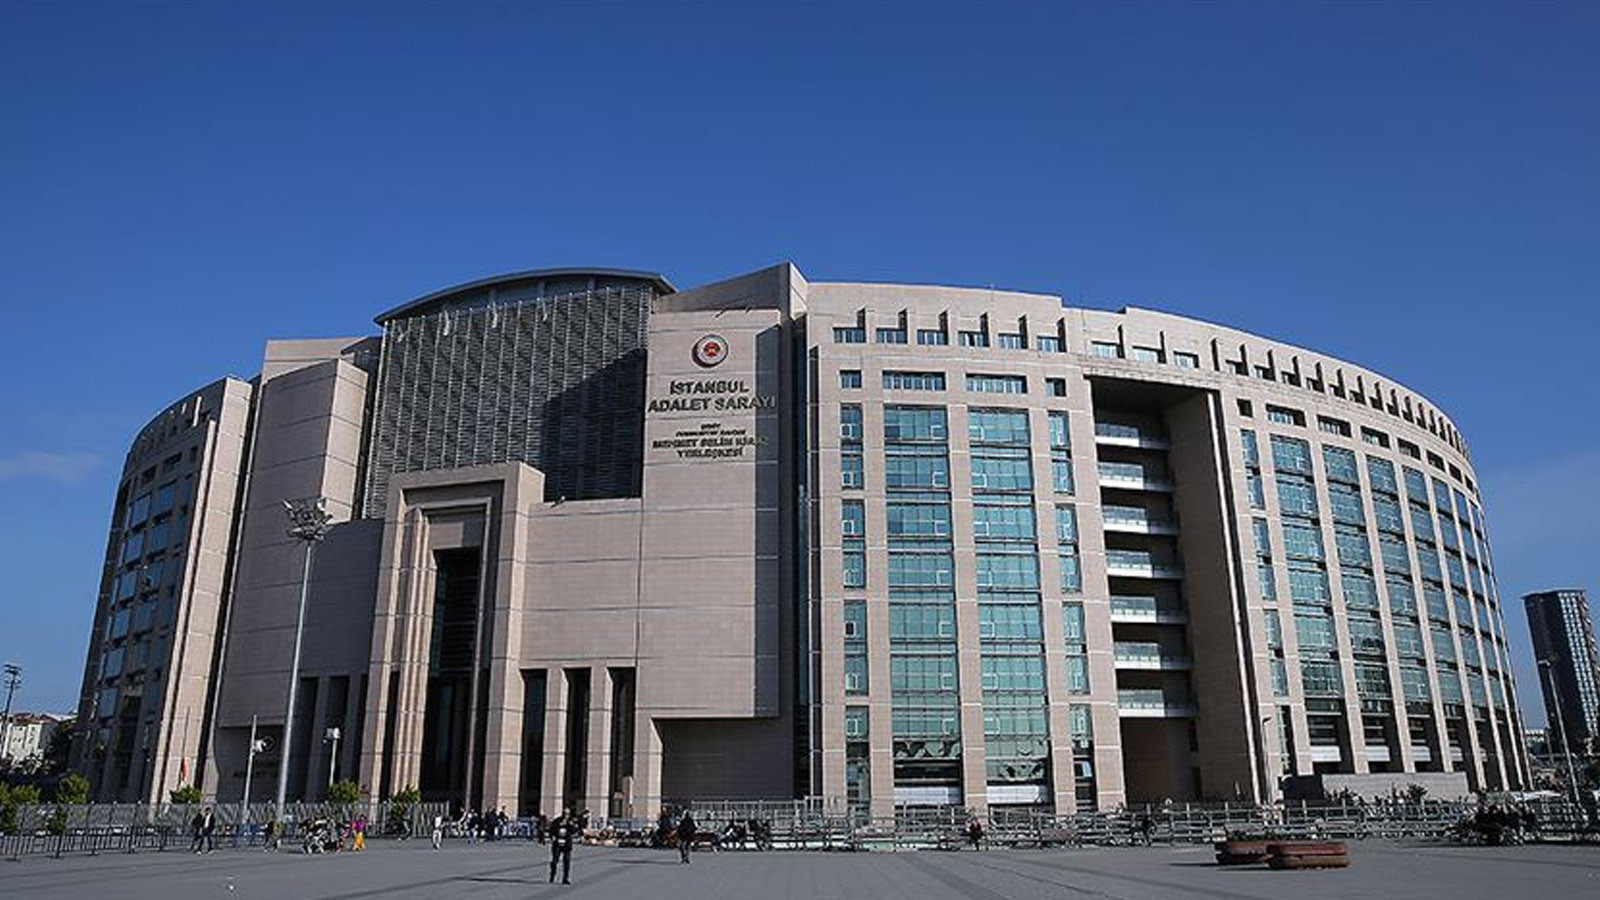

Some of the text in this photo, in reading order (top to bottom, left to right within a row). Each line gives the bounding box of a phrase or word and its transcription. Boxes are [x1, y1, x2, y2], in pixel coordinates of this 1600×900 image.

[670, 380, 750, 395] İSTANBUL
[648, 395, 776, 413] ADALET SARAYI
